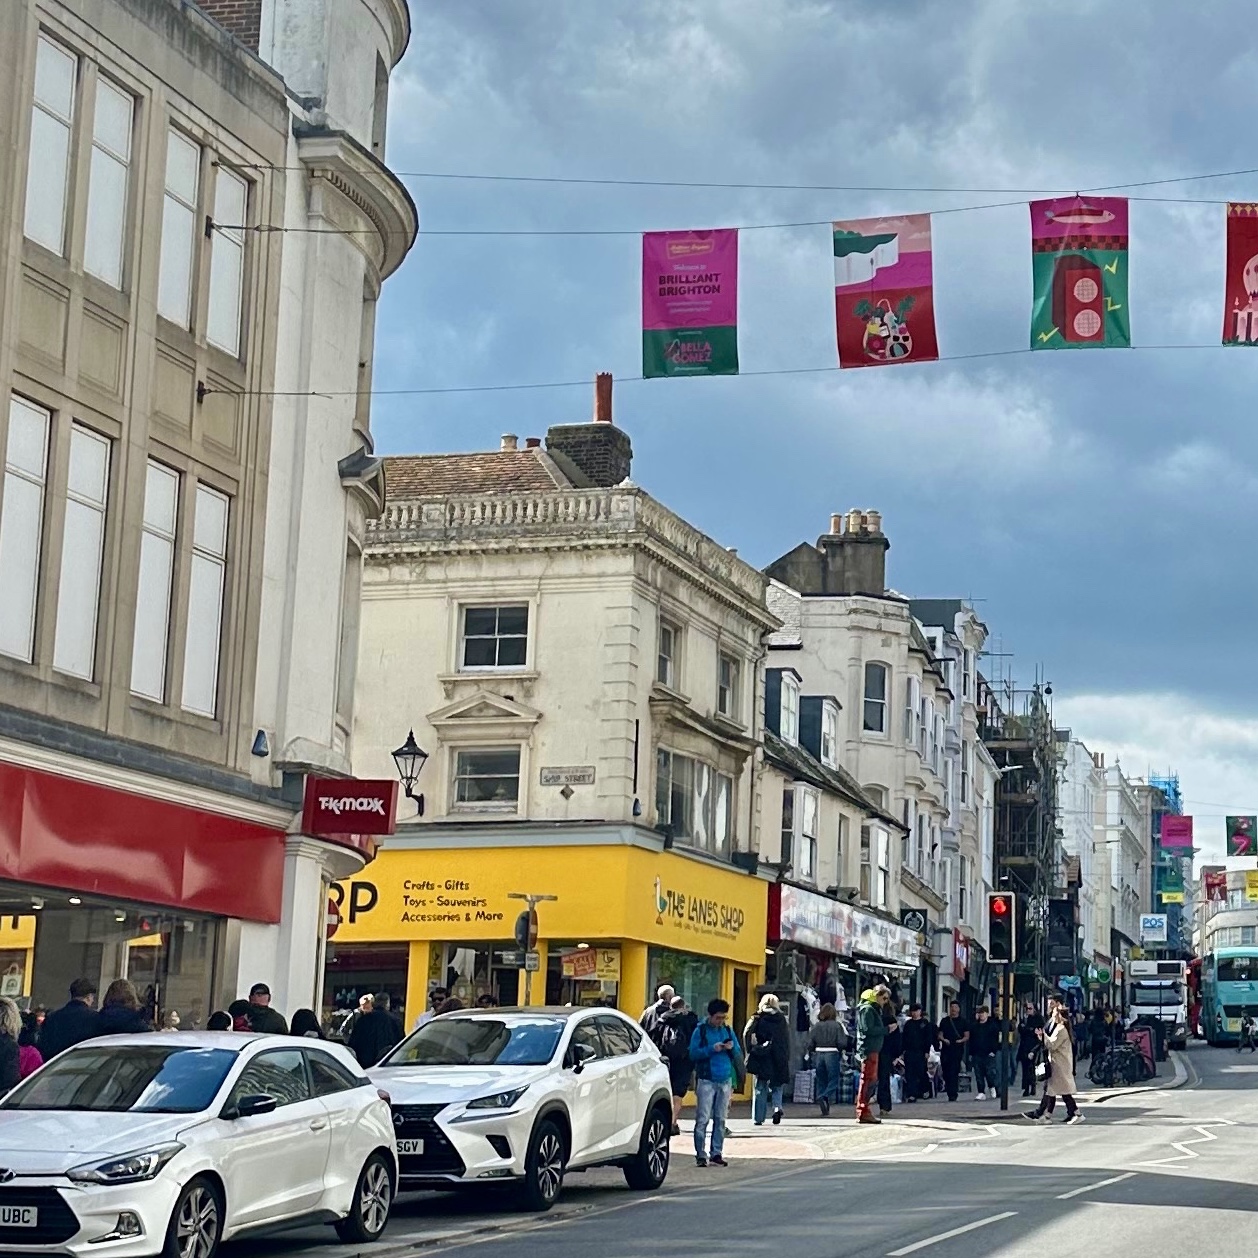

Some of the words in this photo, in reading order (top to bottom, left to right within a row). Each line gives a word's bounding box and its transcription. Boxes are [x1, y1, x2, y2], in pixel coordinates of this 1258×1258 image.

[658, 285, 721, 296] BRIGHTON
[403, 880, 435, 891] Crafts
[444, 880, 470, 891] Gifts
[403, 895, 427, 908] Toys
[436, 896, 487, 907] Souvenirs
[401, 911, 461, 922] Accessories
[475, 911, 503, 921] More
[688, 895, 718, 928] LANES
[720, 904, 744, 933] SHOP
[397, 1141, 418, 1152] SGV
[3, 1208, 30, 1223] UBC
